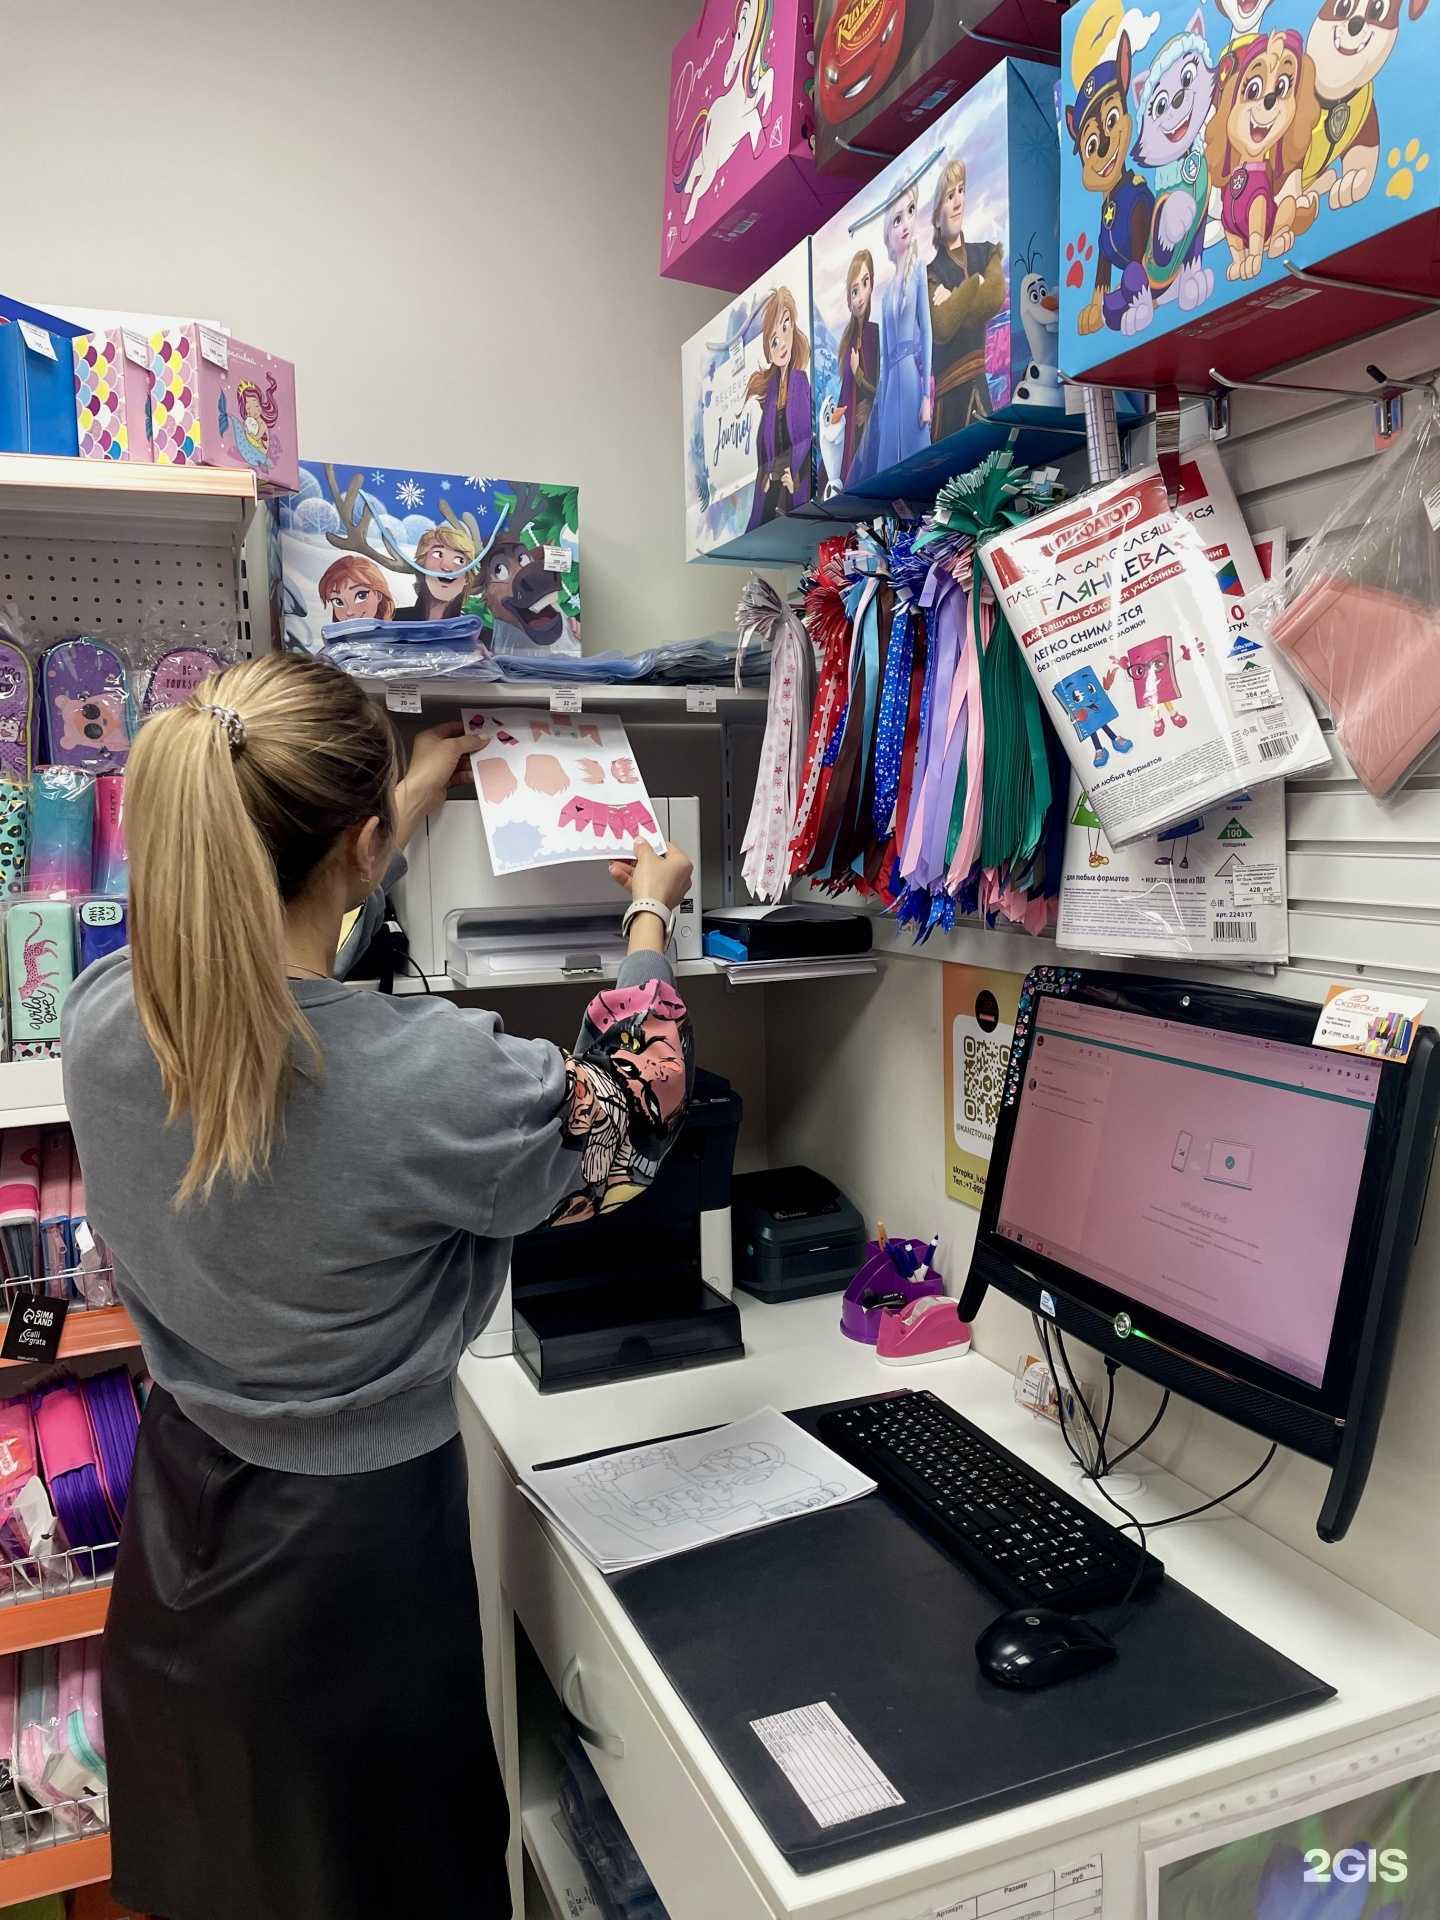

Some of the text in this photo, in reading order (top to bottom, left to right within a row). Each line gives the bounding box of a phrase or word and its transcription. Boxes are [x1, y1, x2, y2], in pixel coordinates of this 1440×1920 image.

[1132, 563, 1184, 596] учебнико
[1101, 774, 1126, 787] любых
[1126, 755, 1163, 777] форматов
[1226, 829, 1243, 838] 100
[1097, 873, 1130, 883] форматов
[35, 1310, 54, 1320] SIMA
[33, 1317, 53, 1327] LAND
[1003, 1880, 1029, 1895] Размер
